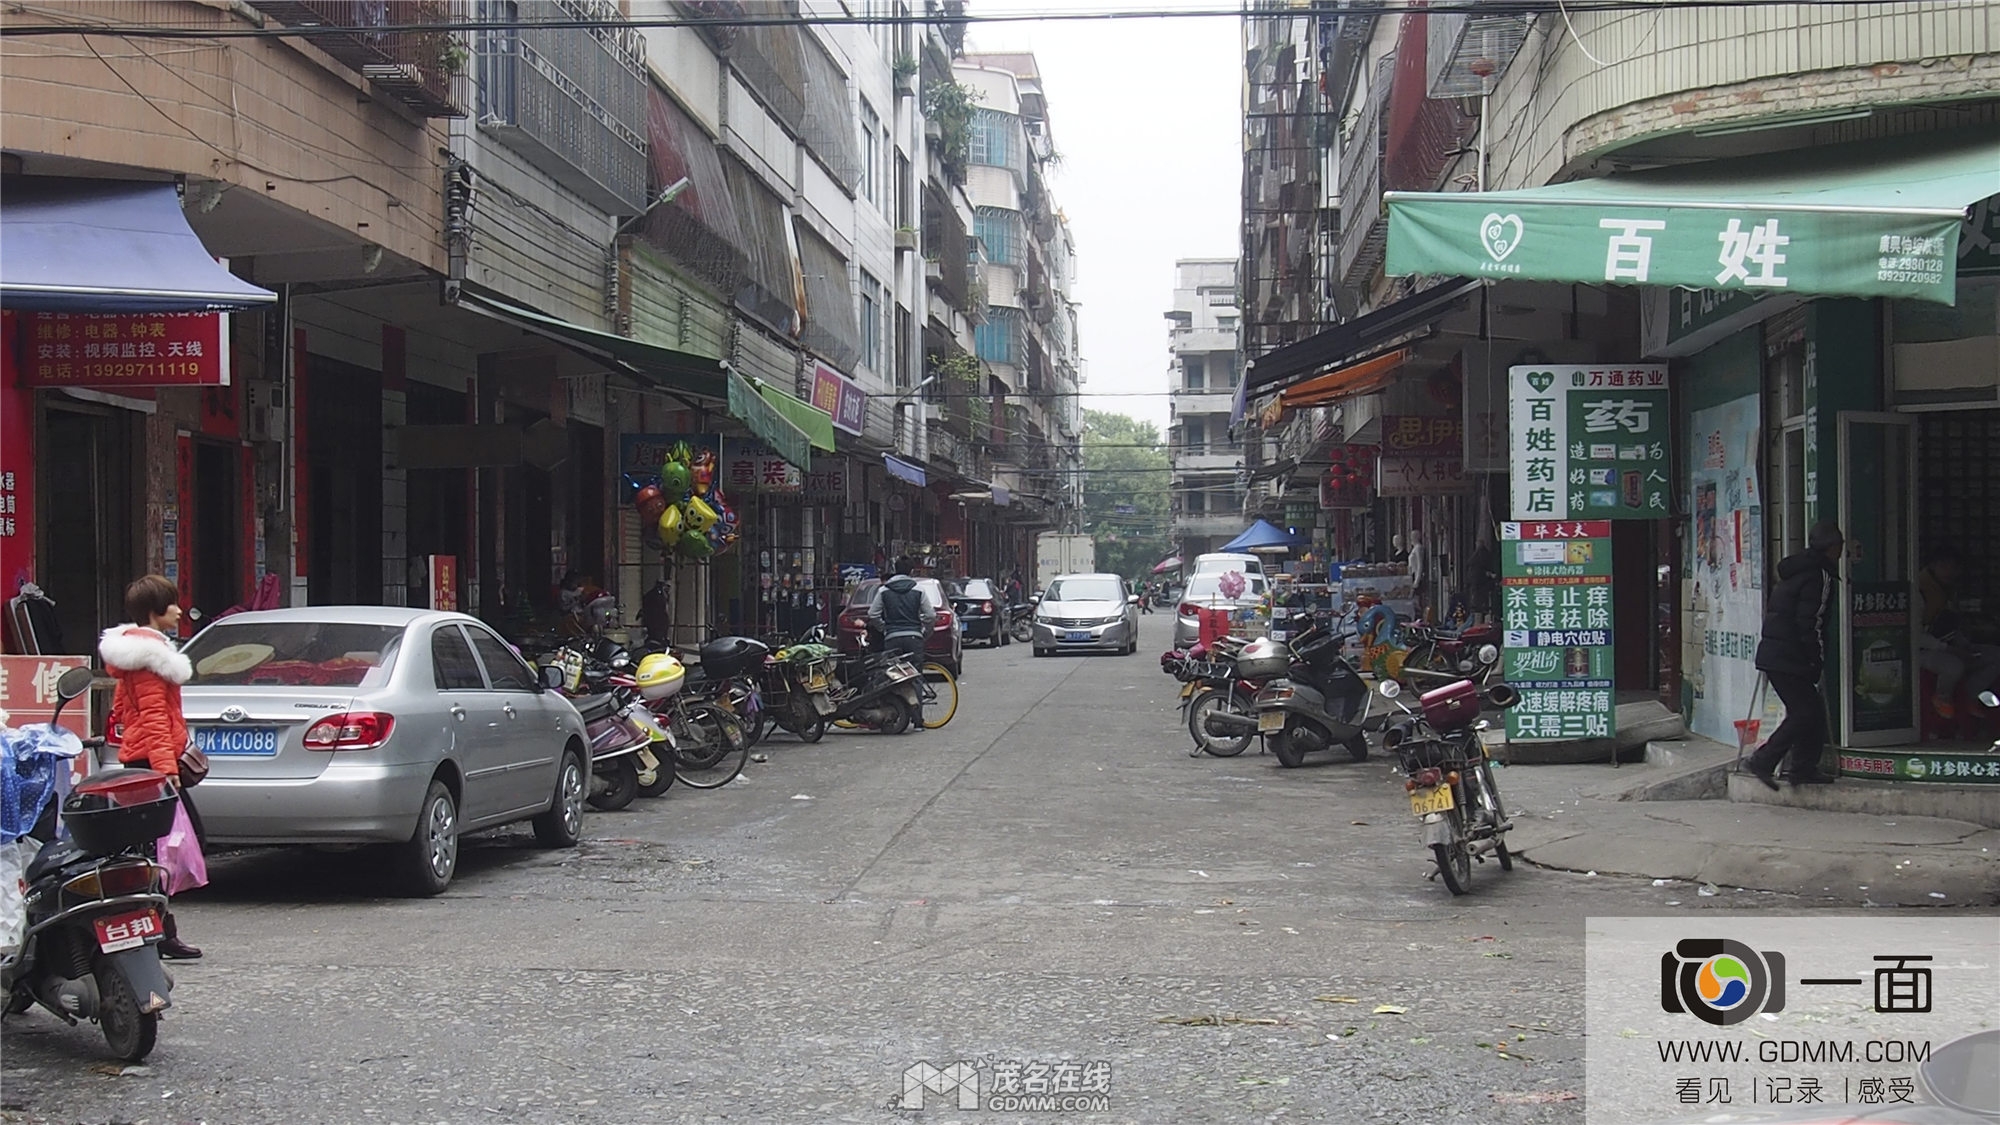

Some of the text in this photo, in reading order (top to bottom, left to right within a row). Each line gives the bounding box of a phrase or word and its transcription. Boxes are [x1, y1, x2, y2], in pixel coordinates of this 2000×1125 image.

[1600, 218, 1790, 287] 百姓
[1588, 370, 1664, 387] 万通药业
[1582, 399, 1653, 434] 药
[1525, 397, 1557, 513] 百姓药店
[731, 459, 786, 486] 童装
[1507, 586, 1609, 608] 杀毒止痒
[1507, 608, 1609, 630] 快速祛除
[1537, 631, 1606, 647] 静电穴位贴
[1516, 714, 1608, 738] 只需三贴
[105, 916, 155, 941] 台邦
